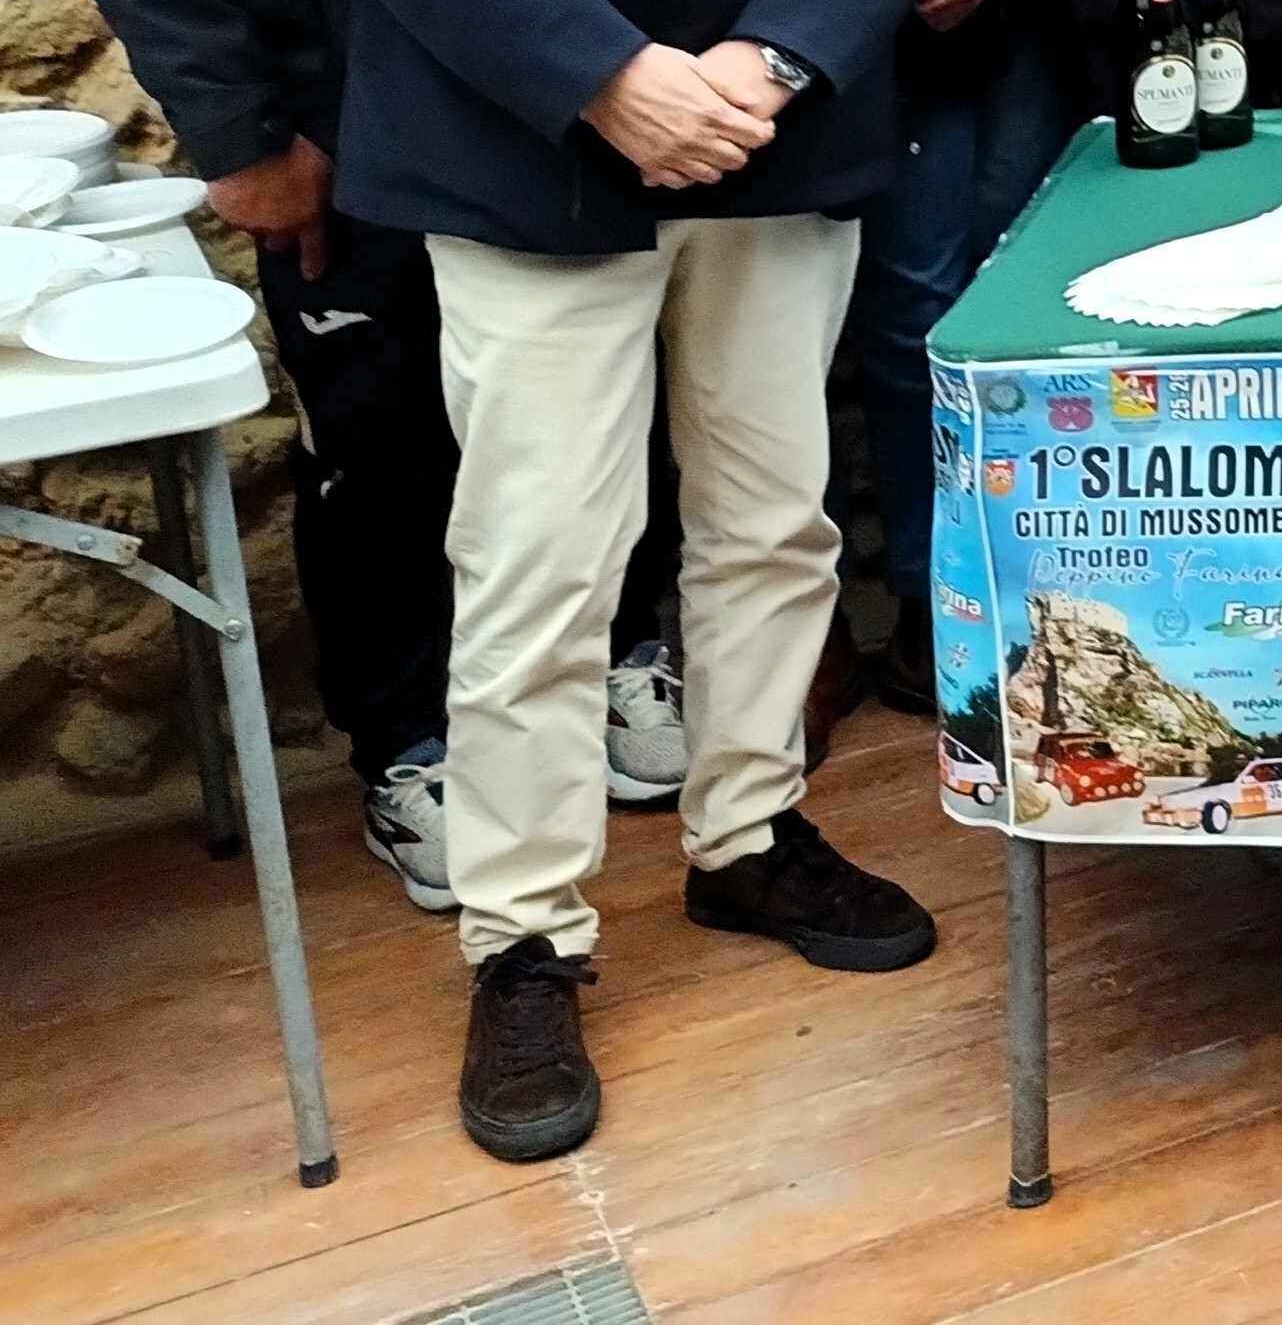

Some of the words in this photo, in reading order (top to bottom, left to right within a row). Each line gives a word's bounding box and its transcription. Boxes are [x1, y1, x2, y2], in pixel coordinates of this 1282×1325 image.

[1015, 503, 1089, 538] CITTÀ
[1101, 509, 1127, 537] DI
[1056, 546, 1148, 568] Trofeo
